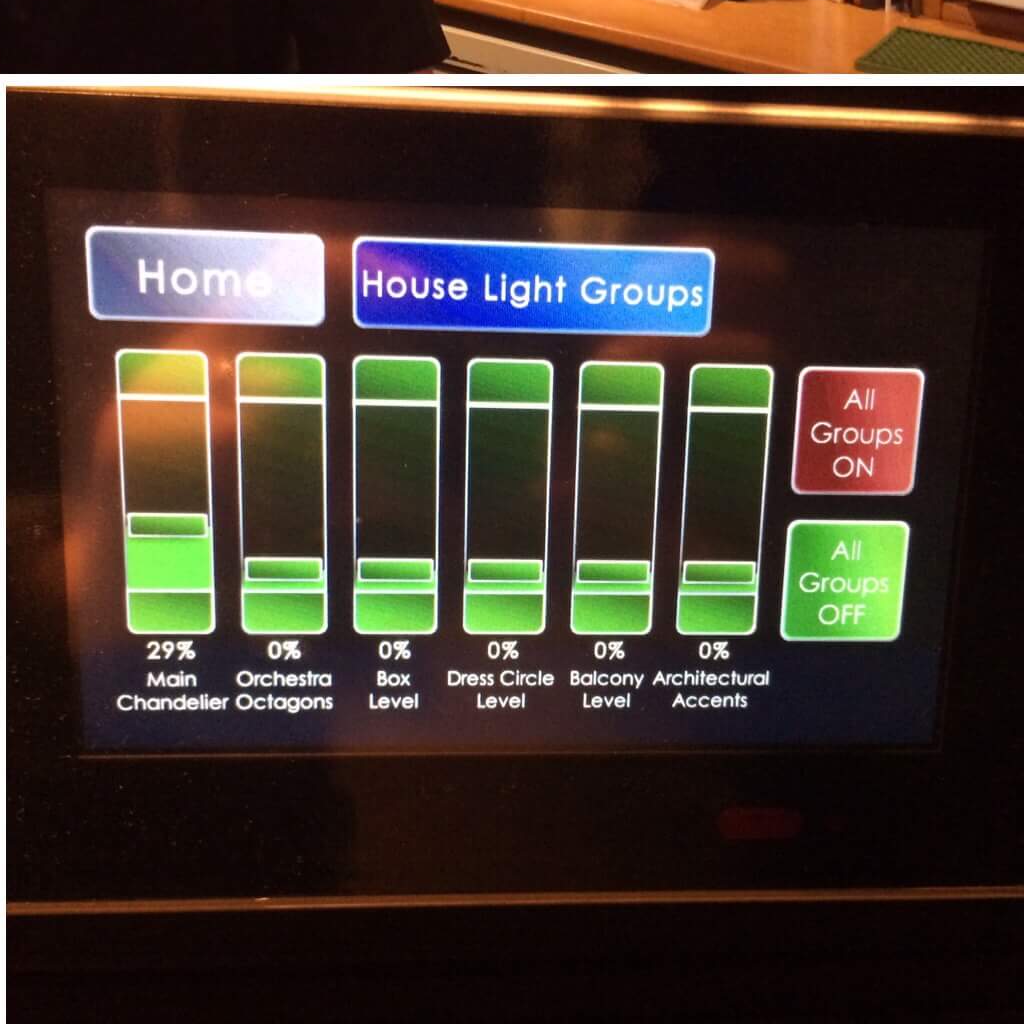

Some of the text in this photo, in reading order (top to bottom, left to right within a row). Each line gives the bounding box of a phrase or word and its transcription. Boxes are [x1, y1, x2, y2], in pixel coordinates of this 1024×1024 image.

[137, 258, 273, 298] Home
[362, 269, 704, 309] House Light Groups
[843, 388, 875, 411] All
[810, 421, 904, 450] Groups
[832, 456, 874, 478] ON
[830, 539, 861, 561] All
[798, 572, 890, 596] Groups
[817, 603, 866, 626] OFF
[146, 640, 196, 661] 29%
[267, 640, 302, 661] 0%
[378, 640, 412, 661] 0%
[487, 640, 519, 660] 0%
[593, 640, 625, 660] 0%
[698, 641, 730, 660] 0%
[146, 671, 197, 688] Main
[236, 670, 333, 688] Orchestra
[376, 671, 411, 687] Box
[446, 670, 554, 687] Dress Circle
[570, 670, 644, 689] Balcony
[652, 670, 771, 687] Architectural
[116, 694, 229, 712] Chandelier
[235, 694, 334, 714] Octagons
[369, 694, 419, 710] Level
[476, 693, 526, 708] Level
[583, 693, 631, 708] Level
[672, 693, 749, 708] Accents
